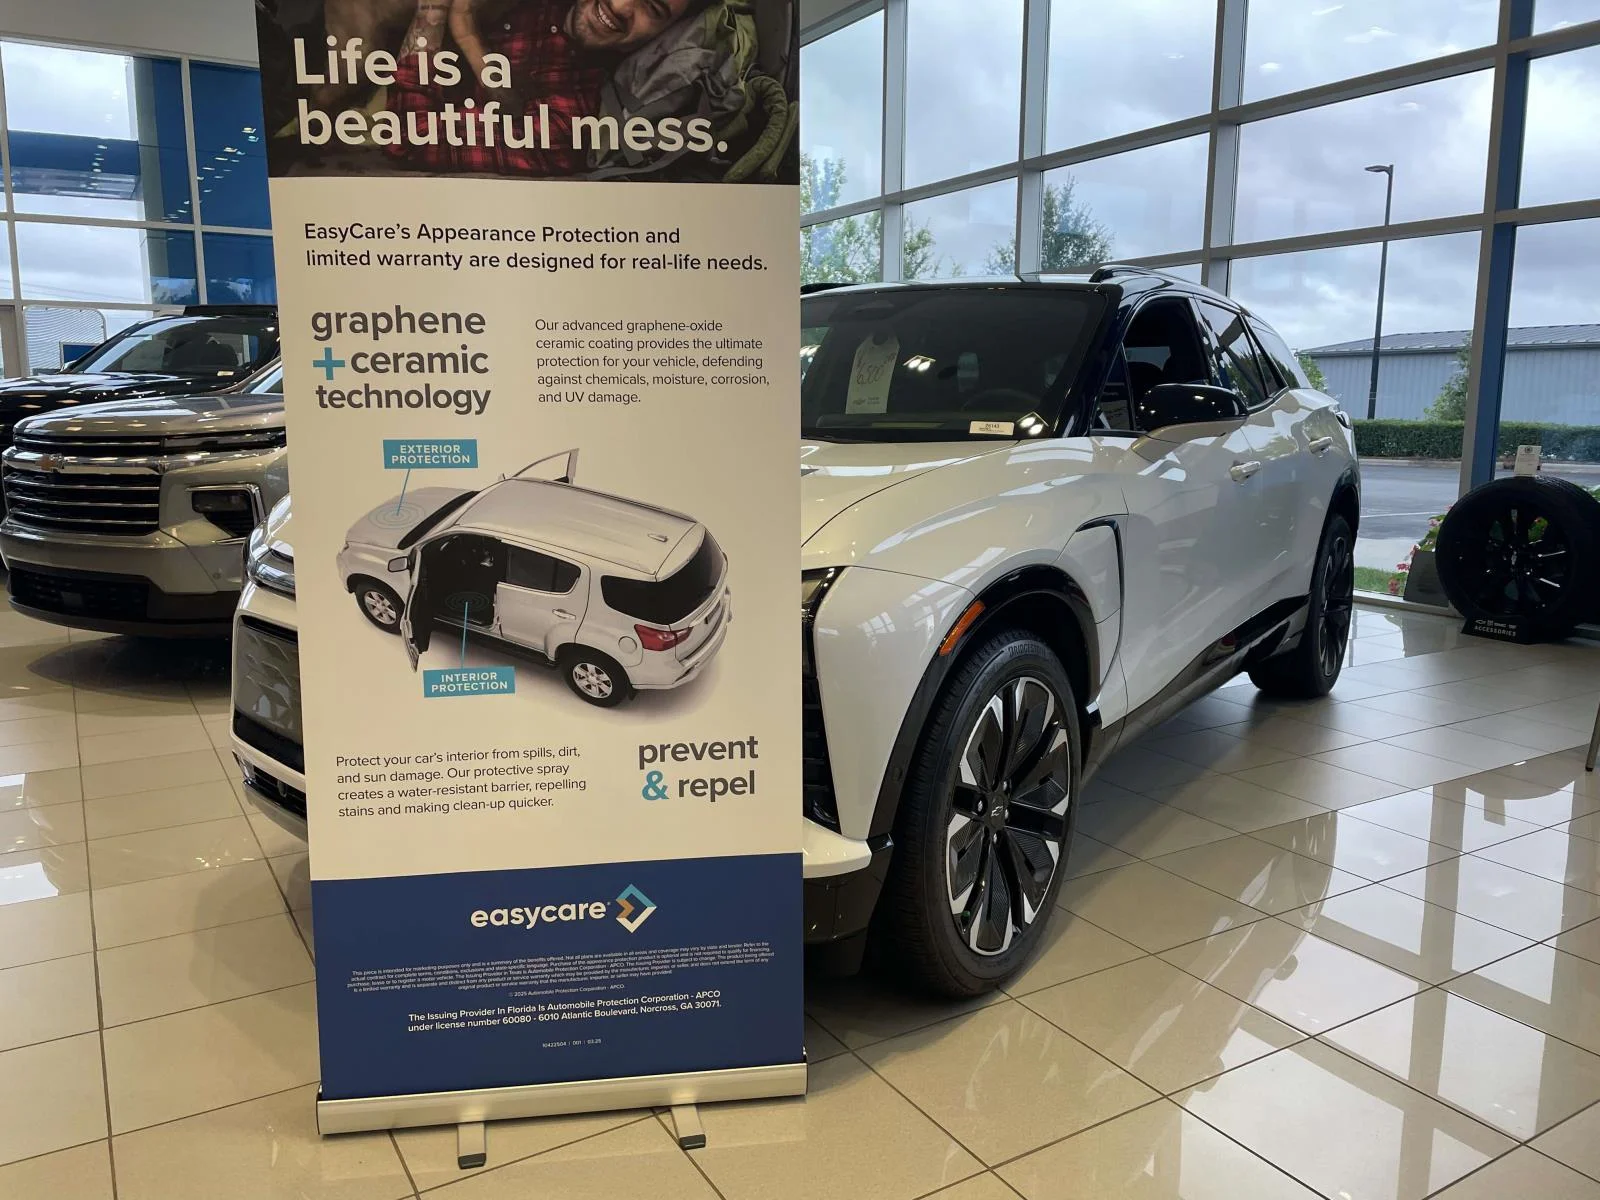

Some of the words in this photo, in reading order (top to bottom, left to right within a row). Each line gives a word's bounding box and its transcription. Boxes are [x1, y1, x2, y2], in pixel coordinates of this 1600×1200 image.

[293, 37, 398, 86] Life
[416, 38, 461, 86] is
[481, 52, 512, 89] a
[297, 99, 550, 150] beautiful
[572, 114, 728, 153] mess.
[305, 223, 410, 242] EasyCare’s
[417, 223, 535, 243] Appearance
[543, 226, 638, 242] Protection
[646, 227, 679, 243] and
[307, 249, 370, 265] limited
[377, 252, 462, 270] warranty
[469, 255, 499, 267] are
[507, 252, 593, 272] designed
[600, 253, 625, 268] for
[632, 254, 700, 269] real-life
[707, 254, 767, 270] needs.
[311, 305, 485, 342] graphene
[535, 319, 558, 330] Our
[562, 320, 622, 330] advanced
[626, 320, 722, 333] graphene-oxide
[536, 338, 584, 348] ceramic
[588, 337, 633, 351] coating
[637, 338, 689, 351] provides
[692, 338, 712, 349] the
[715, 337, 762, 349] ultimate
[351, 346, 489, 373] ceramic
[537, 356, 598, 368] protection
[602, 356, 619, 366] for
[622, 358, 649, 369] your
[652, 356, 698, 368] vehicle,
[702, 355, 762, 369] defending
[537, 373, 582, 387] against
[585, 373, 648, 385] chemicals,
[652, 374, 707, 385] moisture,
[711, 373, 769, 385] corrosion,
[316, 384, 490, 414] technology
[538, 392, 561, 402] and
[565, 391, 584, 402] UV
[588, 391, 640, 405] damage.
[391, 454, 471, 464] PROTECTION
[400, 444, 460, 453] EXTERIOR
[431, 680, 508, 692] PROTECTION
[440, 671, 498, 683] INTERIOR
[336, 756, 381, 766] Protect
[383, 756, 411, 767] your
[415, 752, 443, 763] car’s
[446, 750, 489, 761] interior
[492, 748, 519, 758] from
[523, 747, 554, 760] spills,
[558, 746, 580, 757] dirt,
[639, 736, 758, 769] prevent
[337, 772, 360, 783] and
[364, 774, 386, 782] sun
[390, 771, 443, 782] damage.
[447, 767, 470, 778] Our
[474, 764, 533, 778] protective
[537, 765, 569, 775] spray
[338, 789, 383, 800] creates
[397, 783, 487, 797] water-resistant
[491, 781, 531, 792] barrier,
[535, 779, 585, 792] repelling
[642, 770, 669, 800] &
[678, 771, 755, 802] repel
[338, 806, 374, 816] stains
[378, 804, 400, 815] and
[404, 802, 449, 813] making
[453, 800, 505, 810] clean-up
[508, 796, 553, 809] quicker.
[470, 898, 607, 930] easycare
[427, 1011, 457, 1022] Issuing
[460, 1008, 495, 1017] Provider
[507, 1005, 536, 1013] Florida
[547, 1000, 594, 1010] Automobile
[597, 997, 638, 1006] Protection
[641, 993, 688, 1003] Corporation
[695, 990, 720, 998] APCO
[502, 1015, 531, 1024] 60080
[538, 1013, 558, 1021] 6010
[561, 1010, 592, 1019] Atlantic
[594, 1006, 638, 1016] Boulevard,
[640, 1004, 678, 1012] Norcross,
[695, 1000, 721, 1008] 30071.
